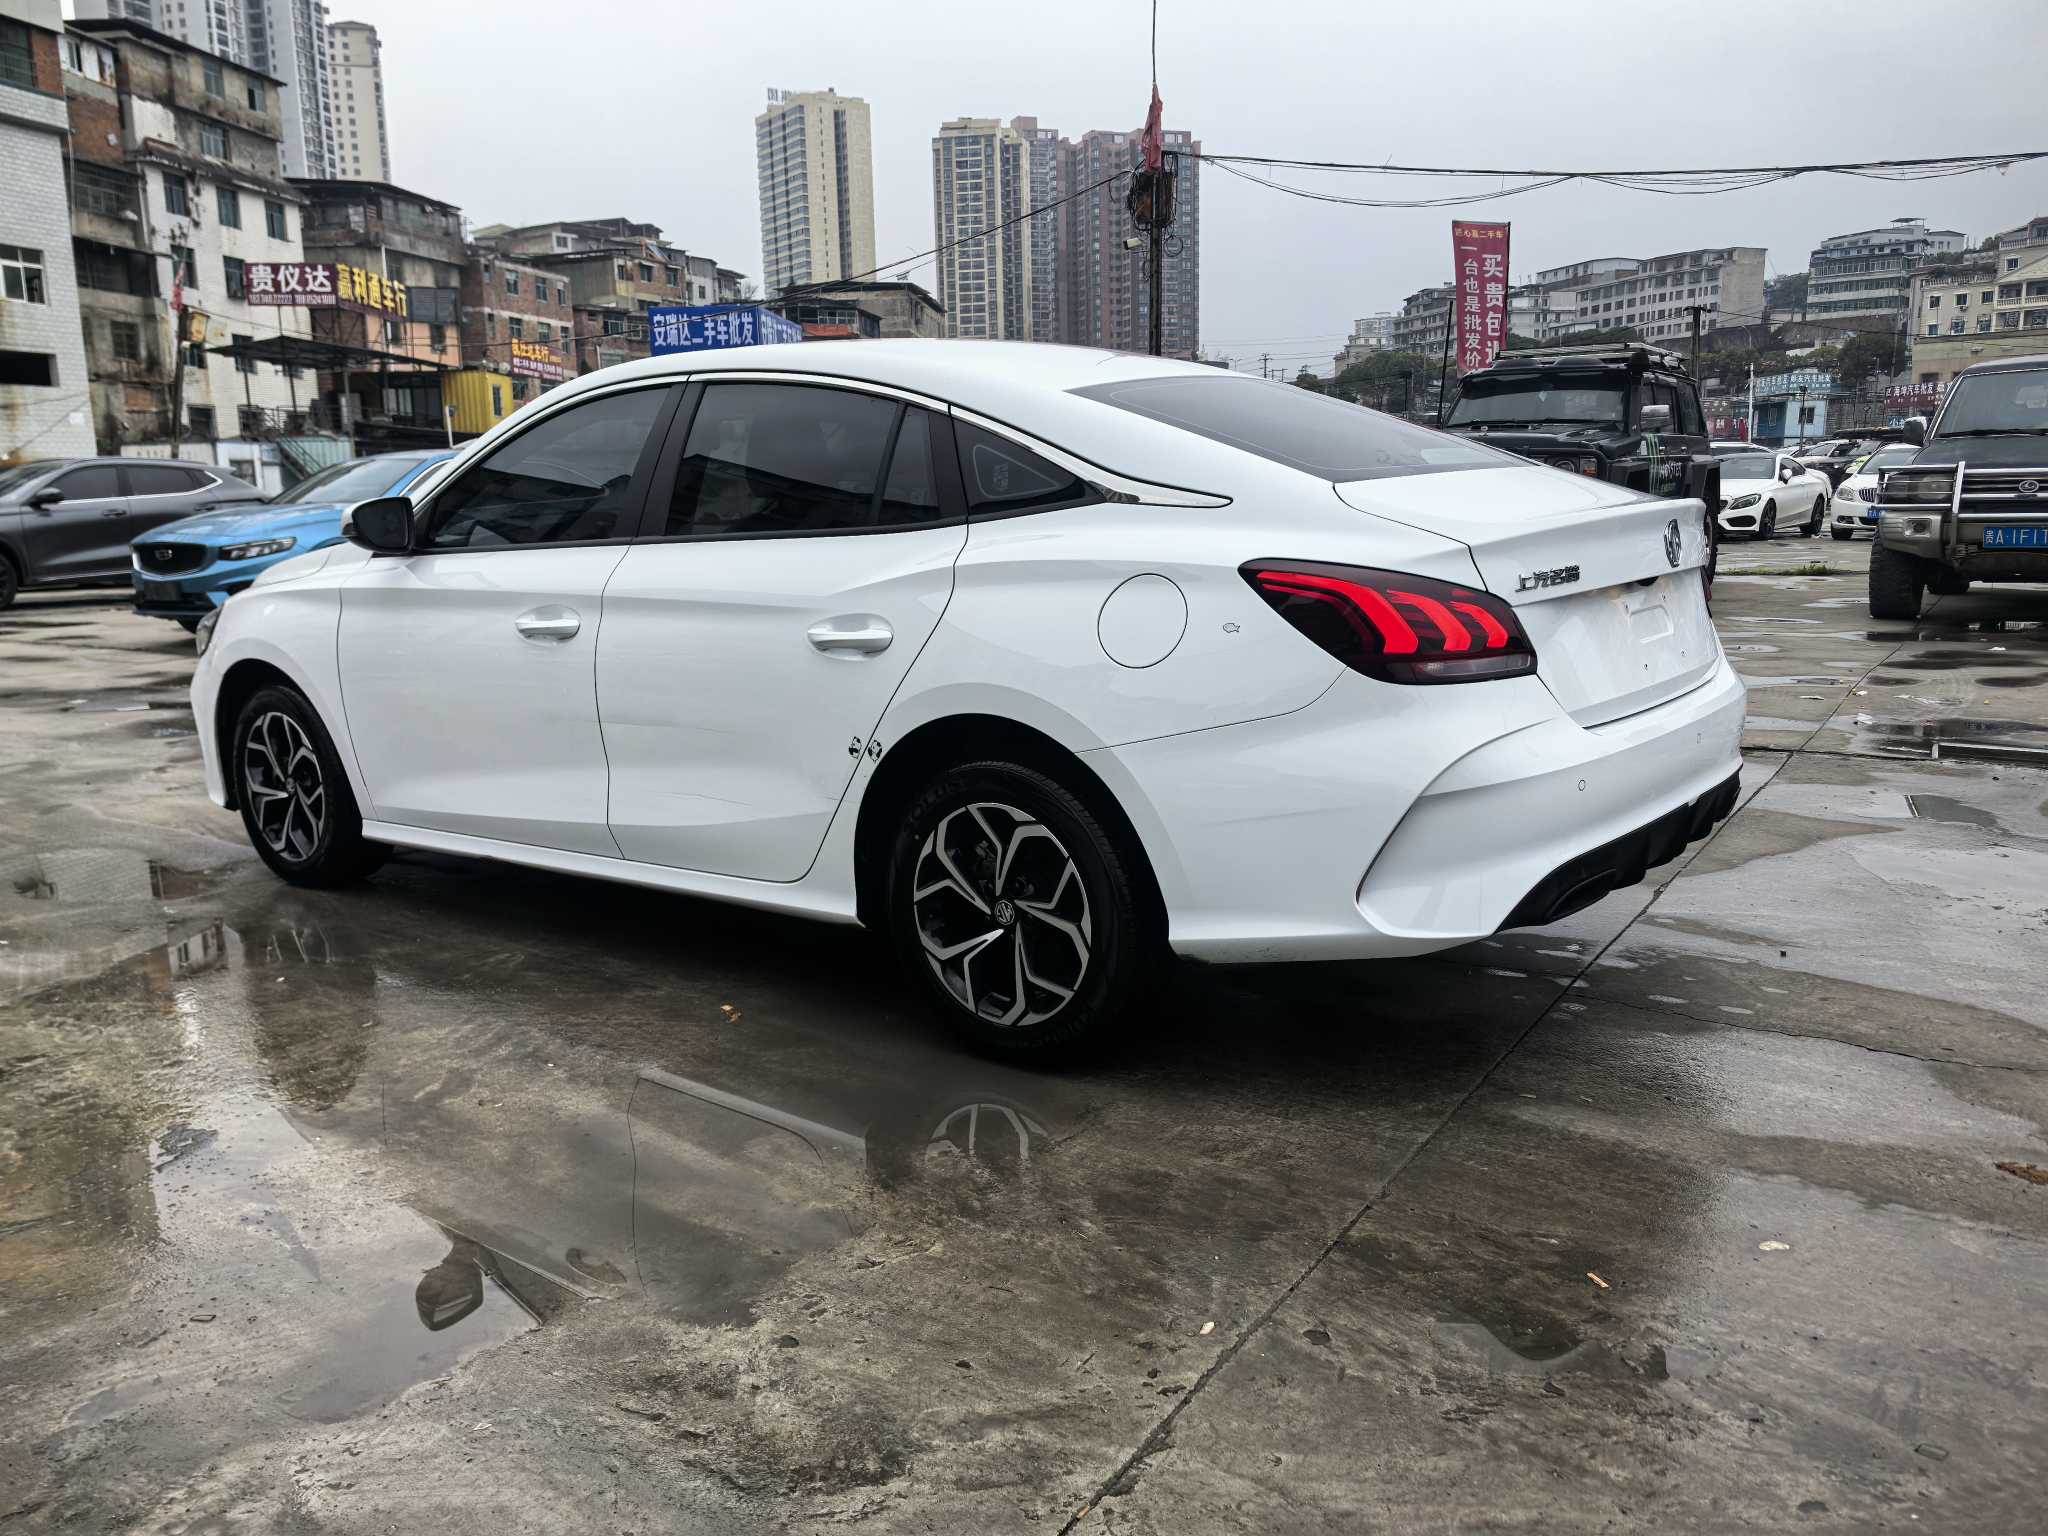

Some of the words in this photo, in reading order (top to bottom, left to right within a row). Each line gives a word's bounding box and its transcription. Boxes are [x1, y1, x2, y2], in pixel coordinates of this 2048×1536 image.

[249, 264, 332, 293] 贵仪达
[1460, 245, 1482, 368] 一台也是批发价
[652, 311, 755, 347] 安瑞达二手车批发
